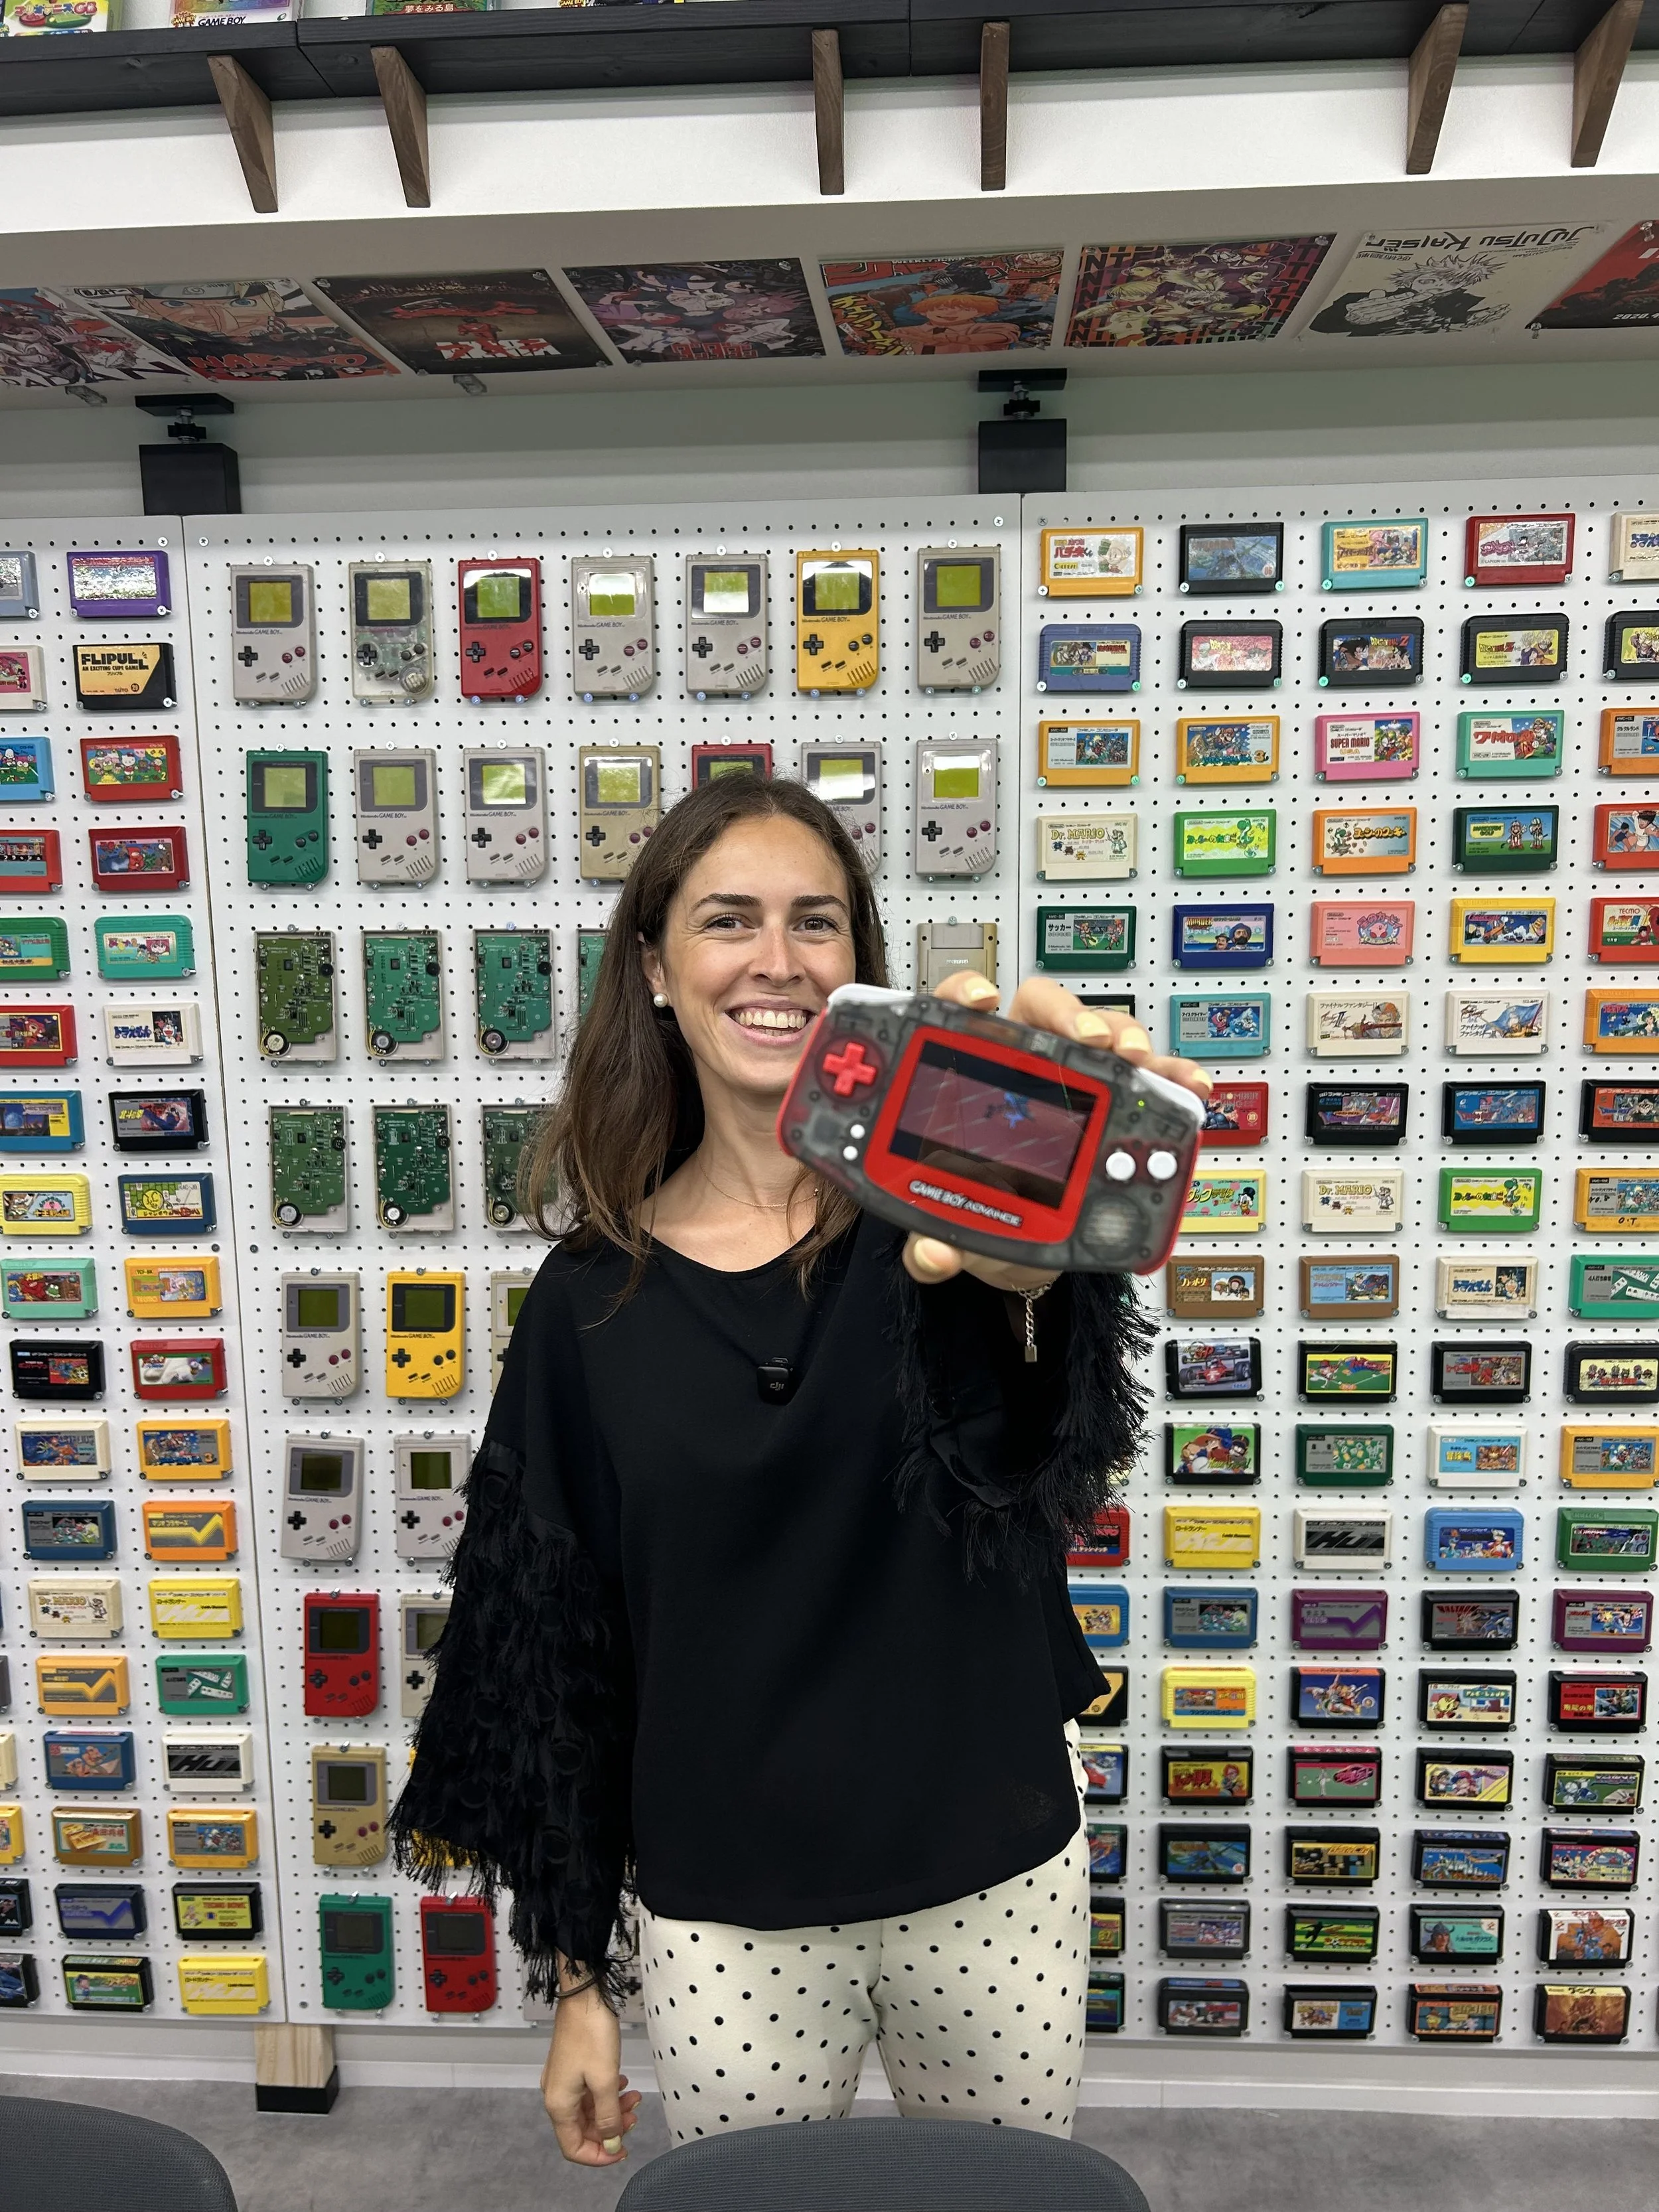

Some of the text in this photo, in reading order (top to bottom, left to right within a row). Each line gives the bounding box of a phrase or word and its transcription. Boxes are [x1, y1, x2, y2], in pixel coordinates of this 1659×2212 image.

[405, 4, 455, 13] 夢をみる島
[198, 18, 226, 27] GAME
[1330, 737, 1370, 749] SUPER MARIO
[1051, 828, 1106, 840] Dr. MARIO
[1048, 923, 1072, 932] サッカー
[113, 1025, 152, 1040] ドラえもん
[1319, 1185, 1372, 1196] Dr. MARIO
[908, 1179, 1024, 1228] GAME BOY ADVANCE
[1453, 1280, 1494, 1292] ドラえもん
[53, 1595, 87, 1606] MARIO
